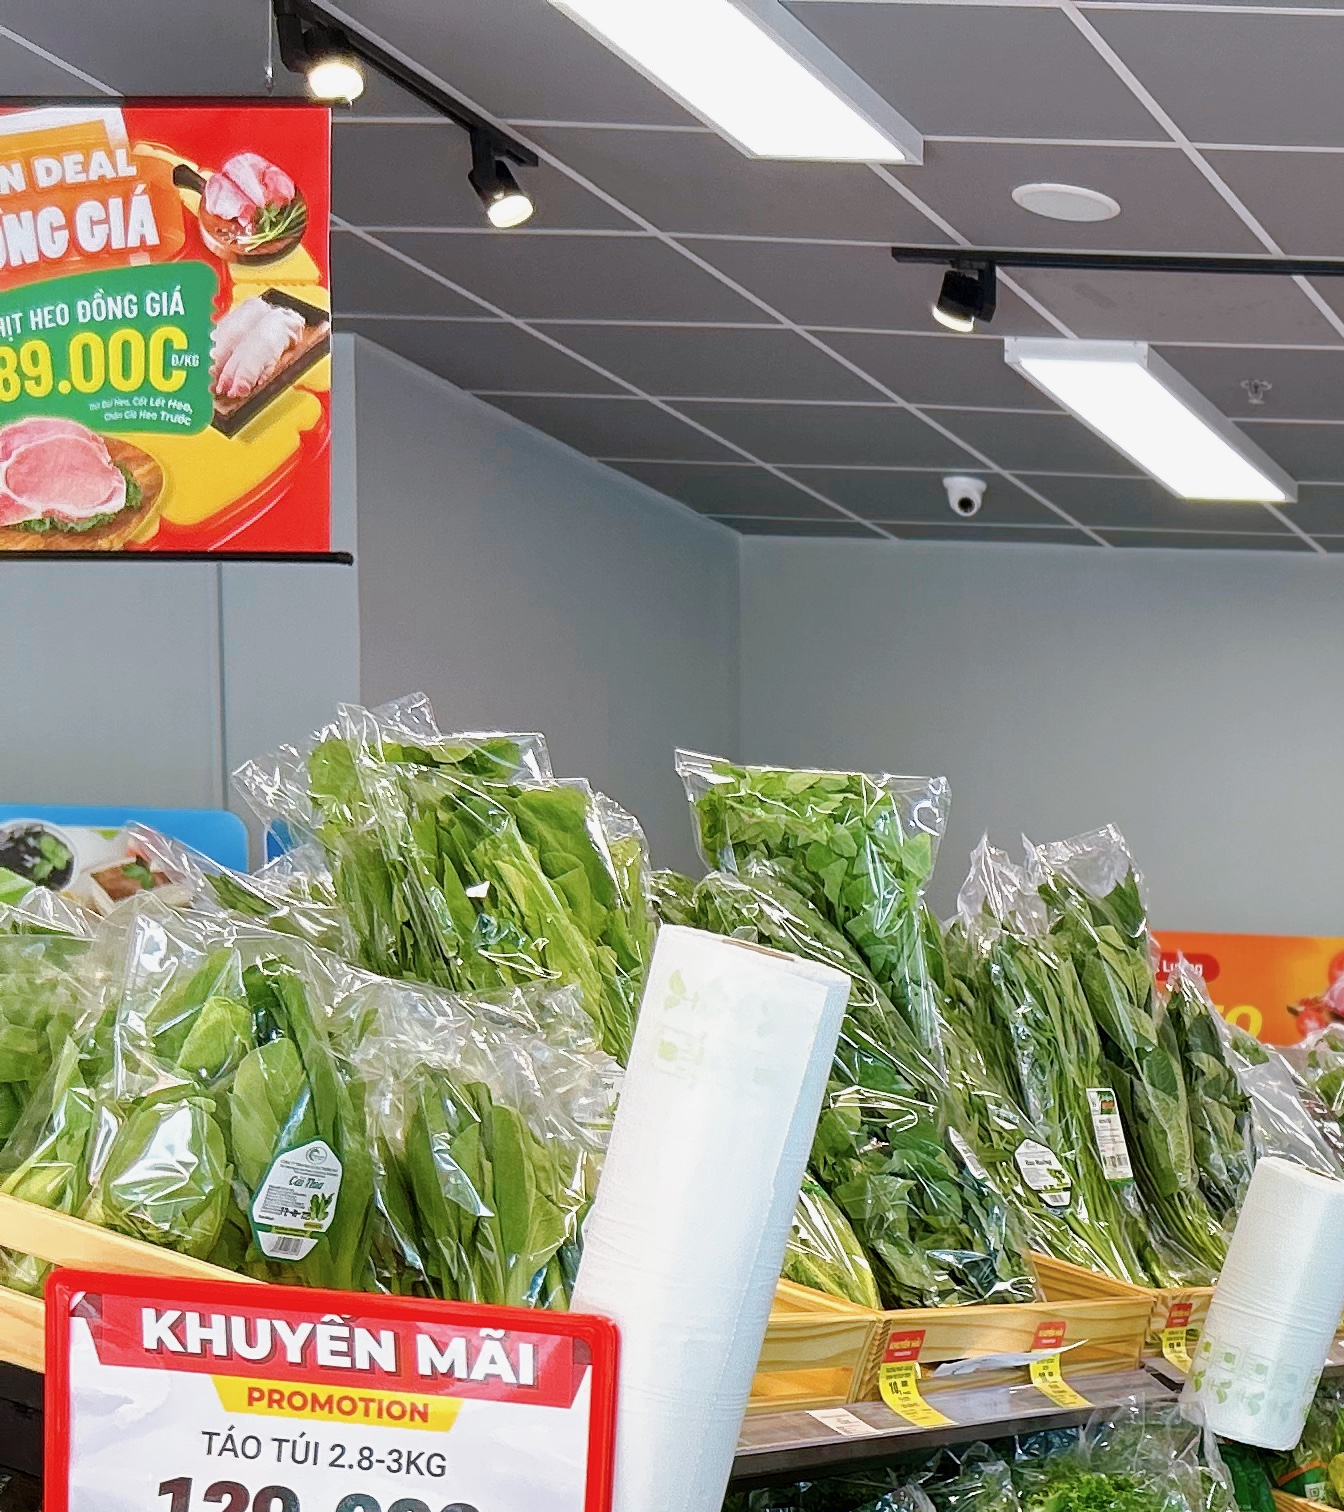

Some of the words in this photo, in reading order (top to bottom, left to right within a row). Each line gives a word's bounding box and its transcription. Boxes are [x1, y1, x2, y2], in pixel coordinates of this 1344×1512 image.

[33, 149, 137, 189] DEAL
[0, 205, 70, 269] NG
[75, 183, 161, 252] GIÁ
[29, 303, 70, 331] HEO
[76, 288, 138, 323] ĐỒNG
[145, 285, 185, 316] GIÁ
[419, 1328, 536, 1386] MÃI
[246, 1386, 430, 1424] PROMOTION
[201, 1425, 262, 1462] TÁO
[272, 1432, 320, 1468] TÚI
[329, 1442, 448, 1479] 2.8-3KG
